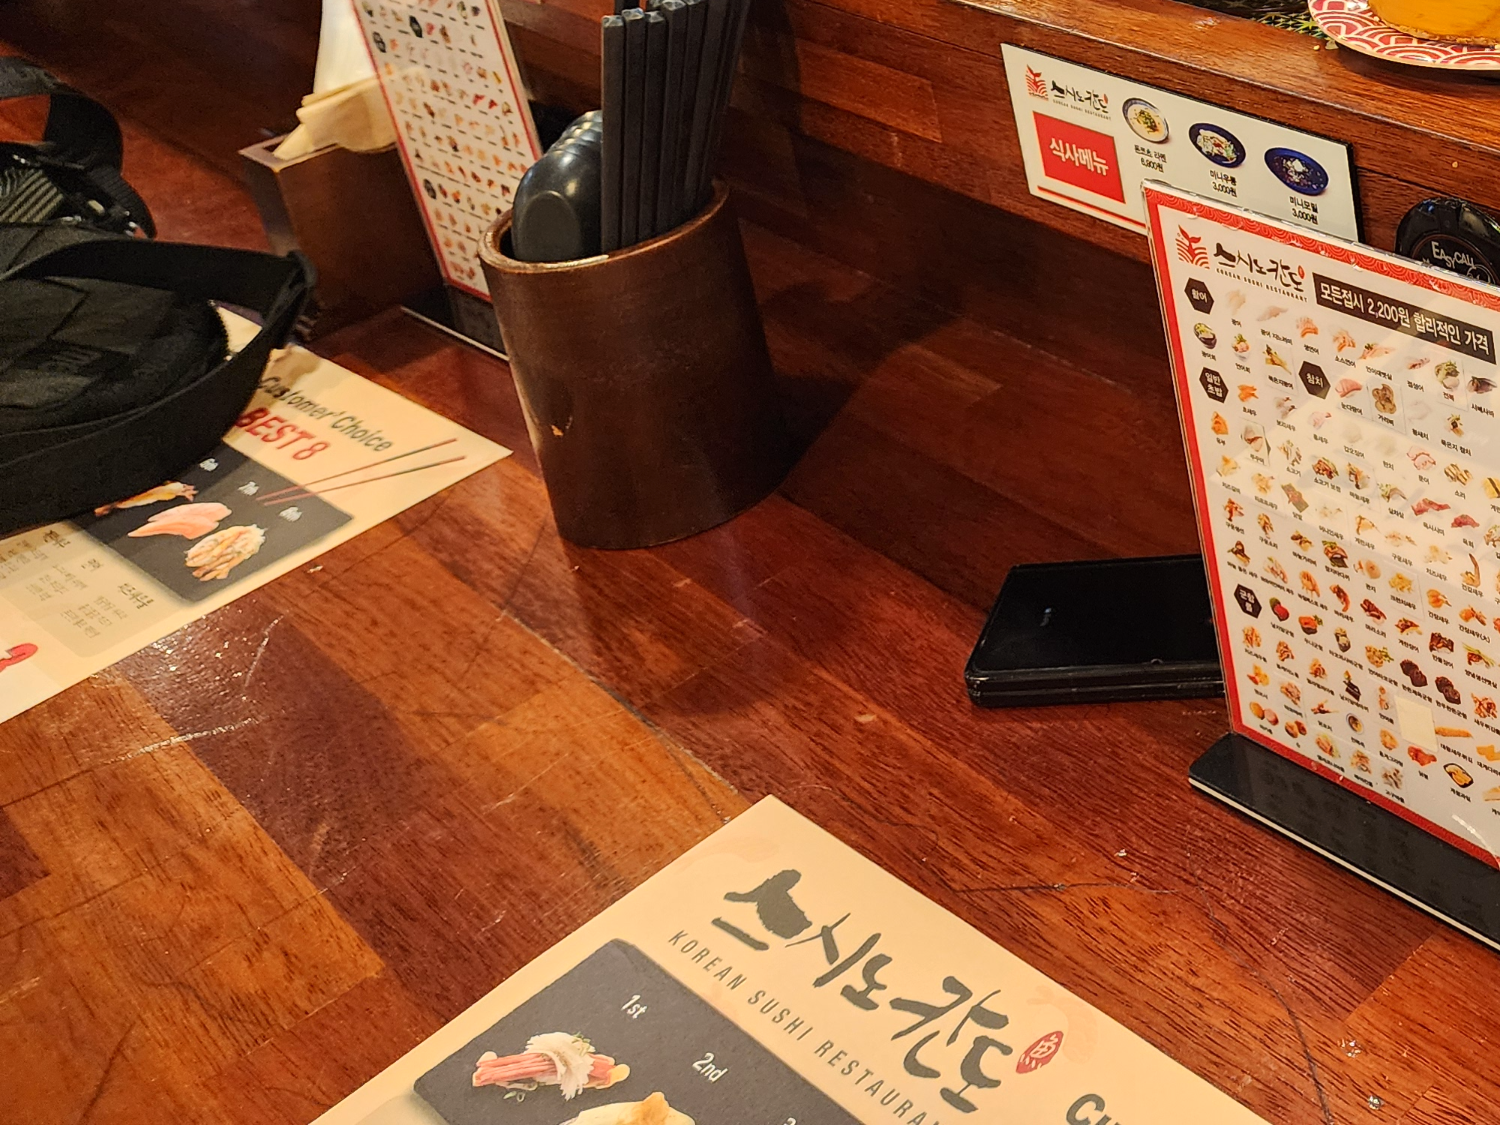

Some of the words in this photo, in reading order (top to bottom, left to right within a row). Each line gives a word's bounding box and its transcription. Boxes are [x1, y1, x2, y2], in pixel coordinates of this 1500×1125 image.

[1049, 137, 1109, 176] 식사메뉴
[1318, 280, 1364, 313] 모든접시
[1366, 296, 1410, 329] 2,200원
[1412, 311, 1461, 345] 합리적인
[1463, 328, 1489, 355] 가격
[1204, 371, 1221, 386] 일반
[1206, 383, 1223, 398] 초밥
[1305, 371, 1323, 388] 참치
[331, 415, 393, 452] Choice
[621, 995, 647, 1019] 1st
[668, 929, 747, 991] KOREAN
[748, 990, 814, 1042] SUSHI
[814, 1039, 940, 1125] RESTAURA
[692, 1052, 728, 1083] 2nd
